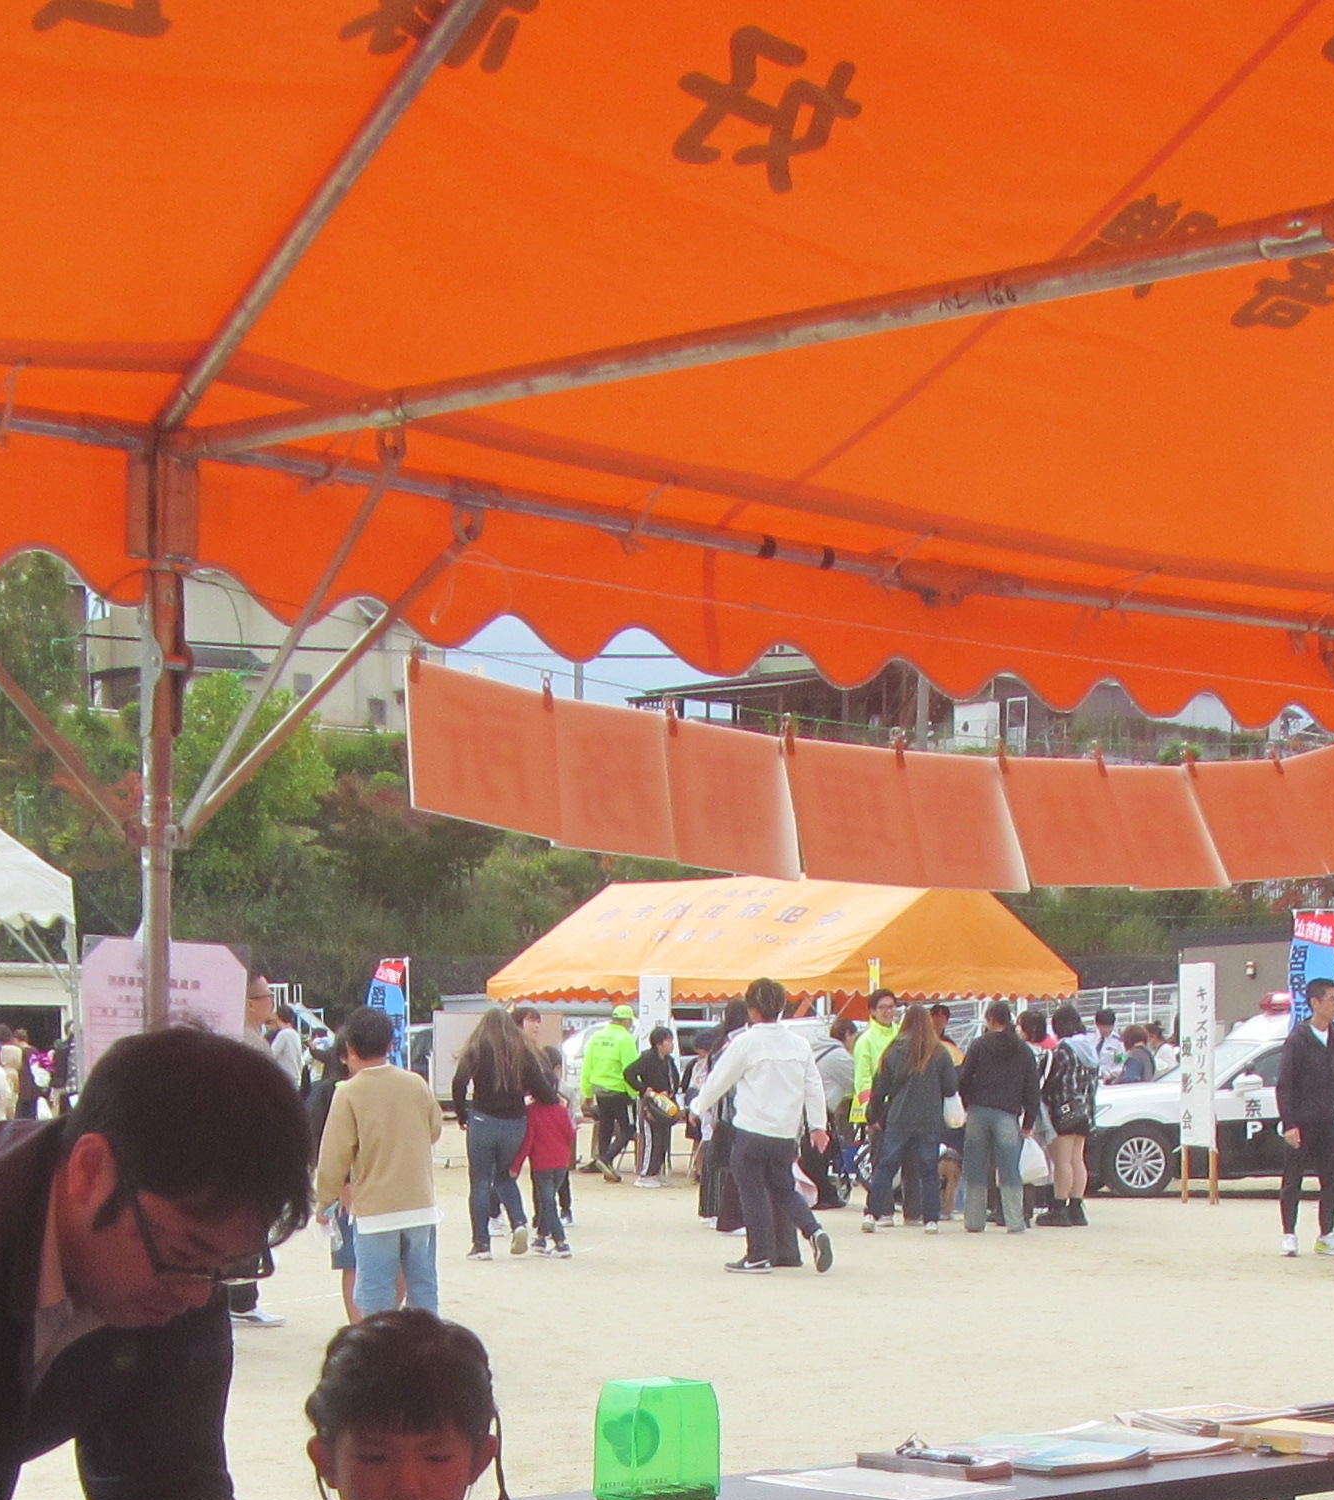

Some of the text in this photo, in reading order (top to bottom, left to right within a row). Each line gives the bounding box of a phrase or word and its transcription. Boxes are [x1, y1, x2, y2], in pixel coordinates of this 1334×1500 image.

[1195, 986, 1209, 1085] キッズポリス
